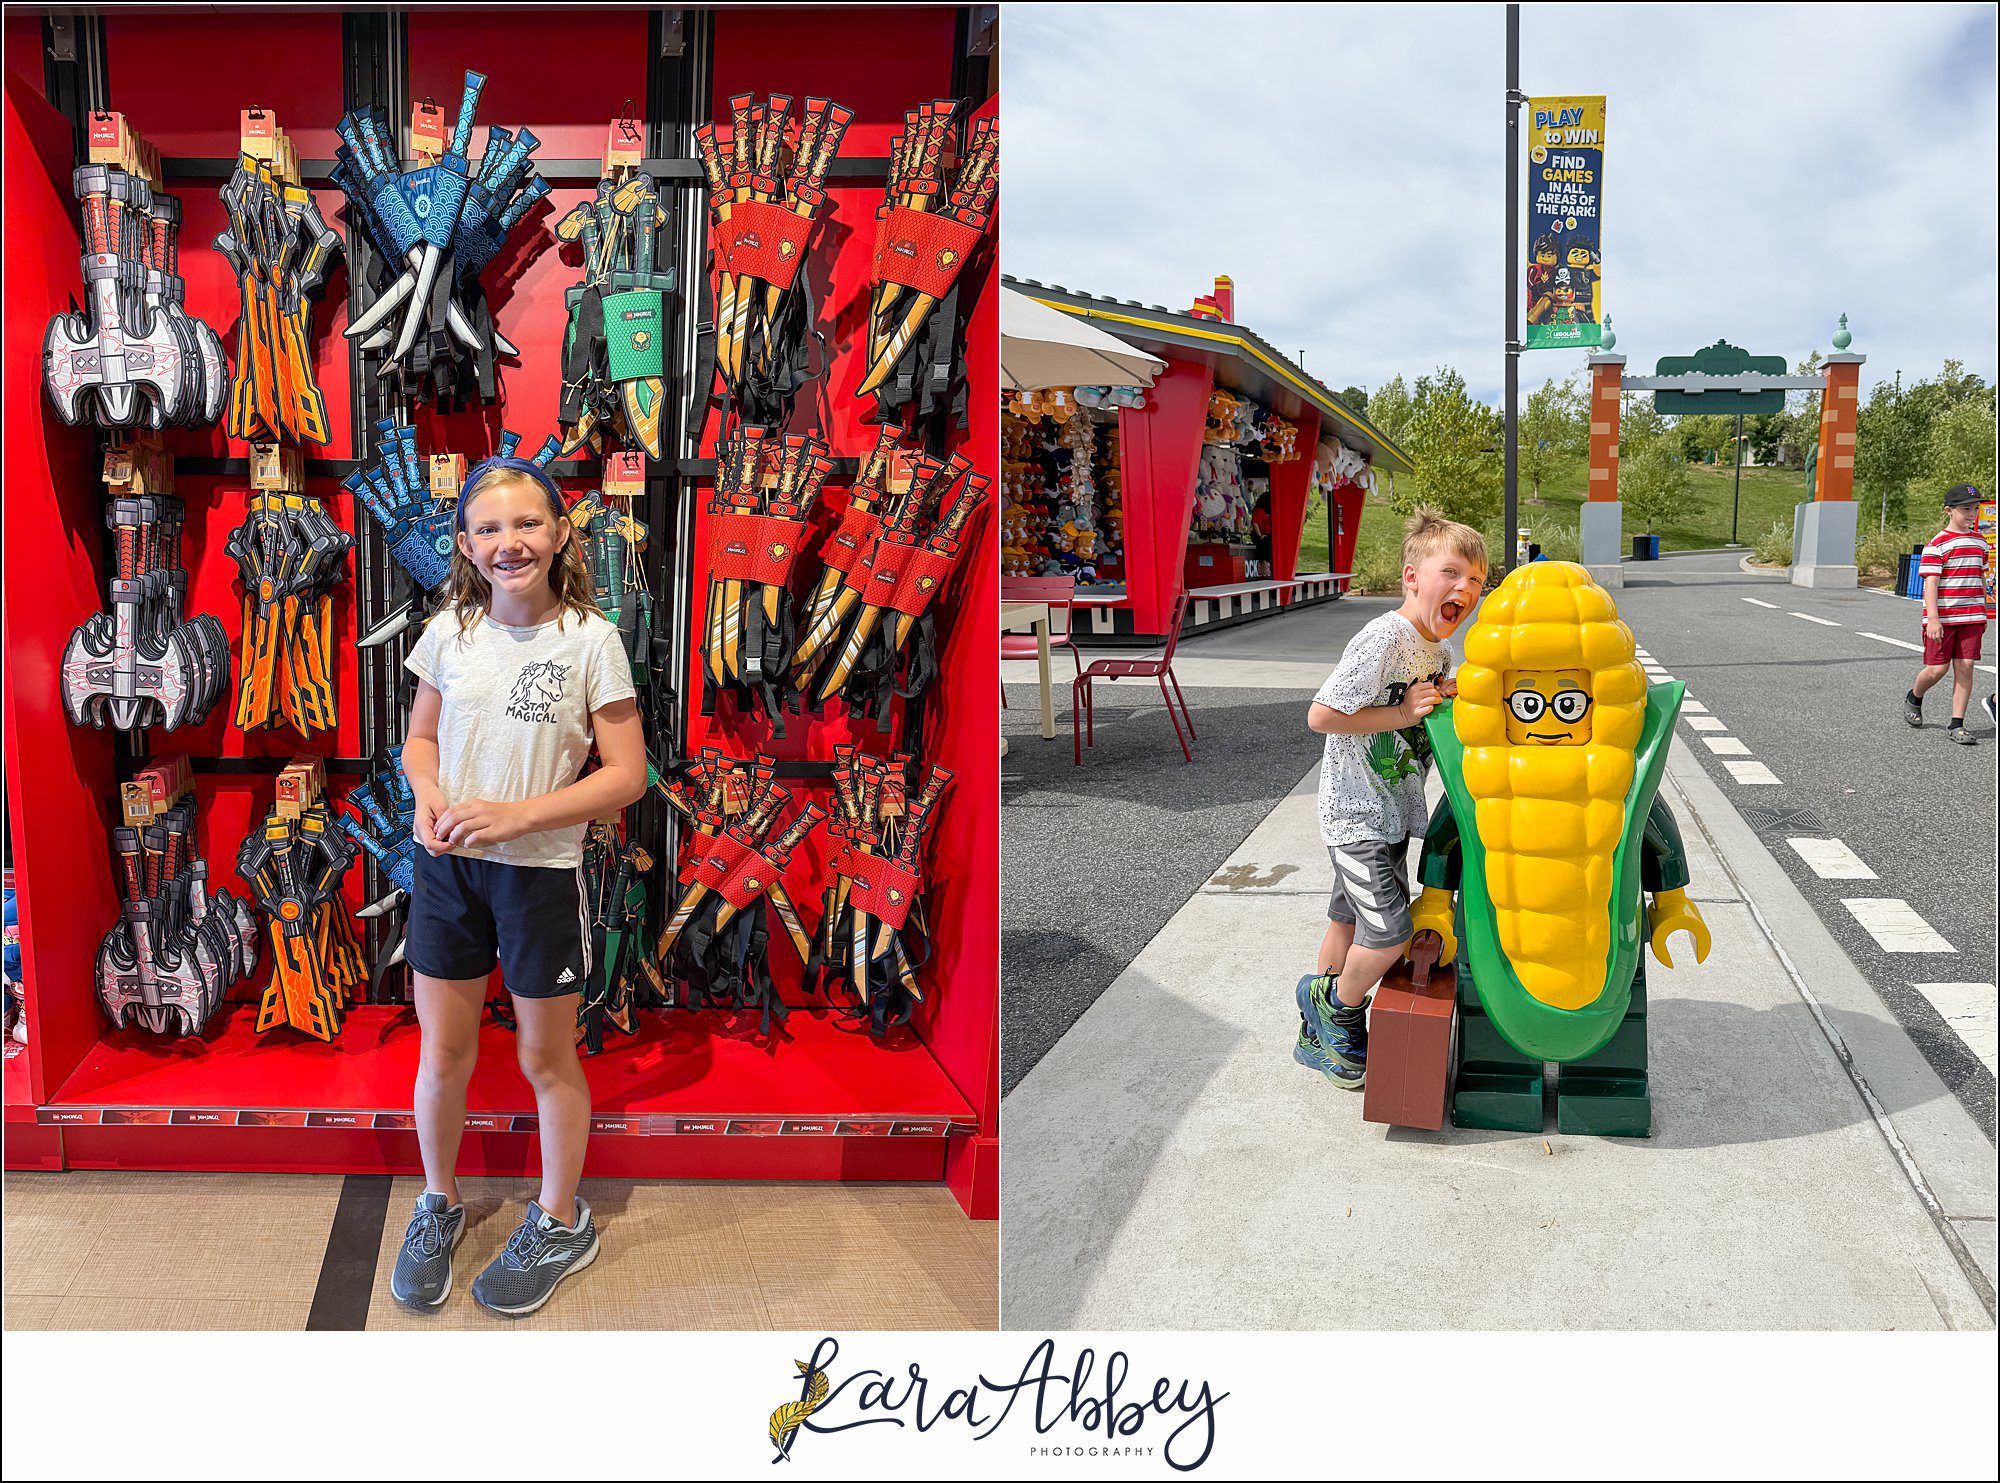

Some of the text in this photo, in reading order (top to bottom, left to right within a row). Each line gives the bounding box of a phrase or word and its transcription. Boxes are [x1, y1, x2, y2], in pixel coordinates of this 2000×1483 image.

[1535, 107, 1582, 129] PLAY
[1544, 129, 1598, 144] to WIN
[1551, 155, 1585, 169] FIND
[1542, 168, 1593, 183] GAMES
[1549, 182, 1585, 194] IN ALL
[1537, 192, 1596, 206] AREAS OF
[1536, 203, 1596, 217] THE PARK!
[520, 700, 551, 712] STAY
[505, 705, 557, 723] MAGICAL
